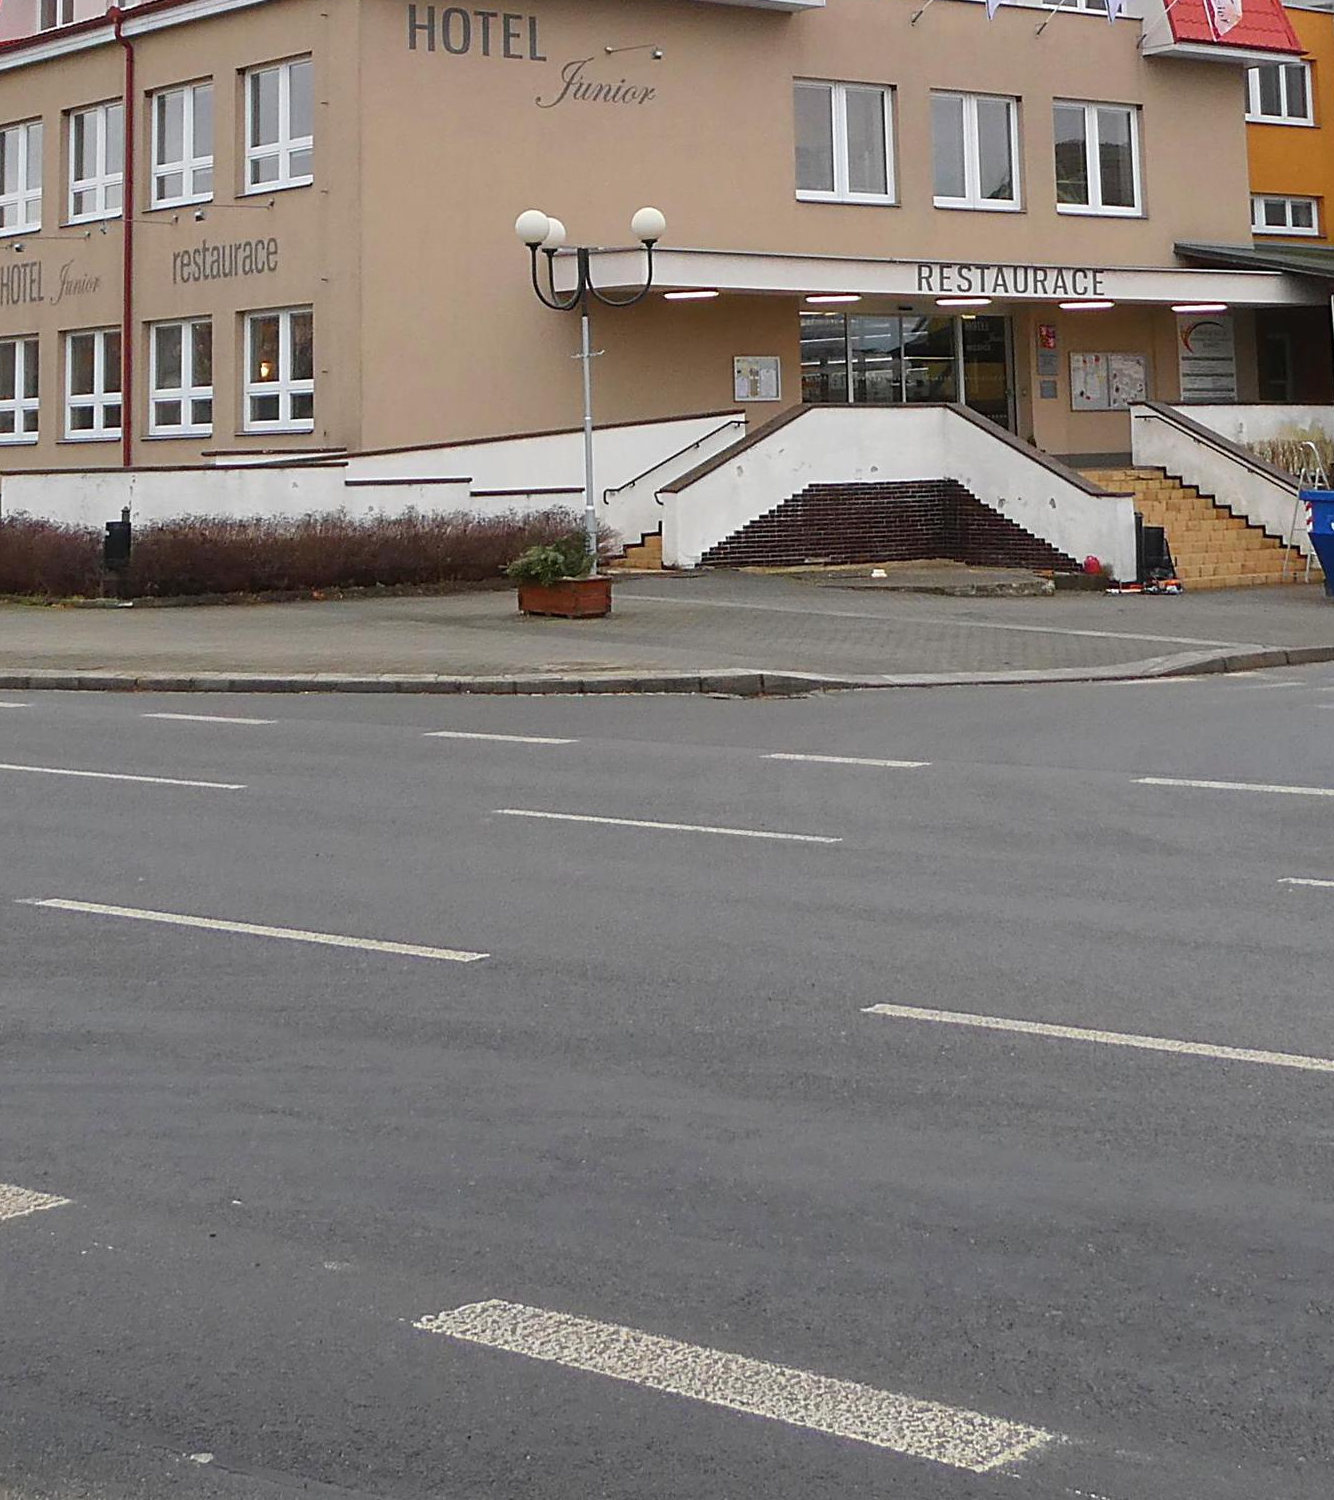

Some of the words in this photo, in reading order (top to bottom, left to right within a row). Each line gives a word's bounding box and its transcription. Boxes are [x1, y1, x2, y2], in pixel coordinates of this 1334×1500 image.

[407, 3, 548, 62] HOTEL
[534, 56, 657, 109] Junior
[0, 260, 45, 307] HOTEL
[50, 258, 101, 306] Junior
[172, 236, 278, 285] restaurace
[917, 264, 1106, 296] RESTAURACE
